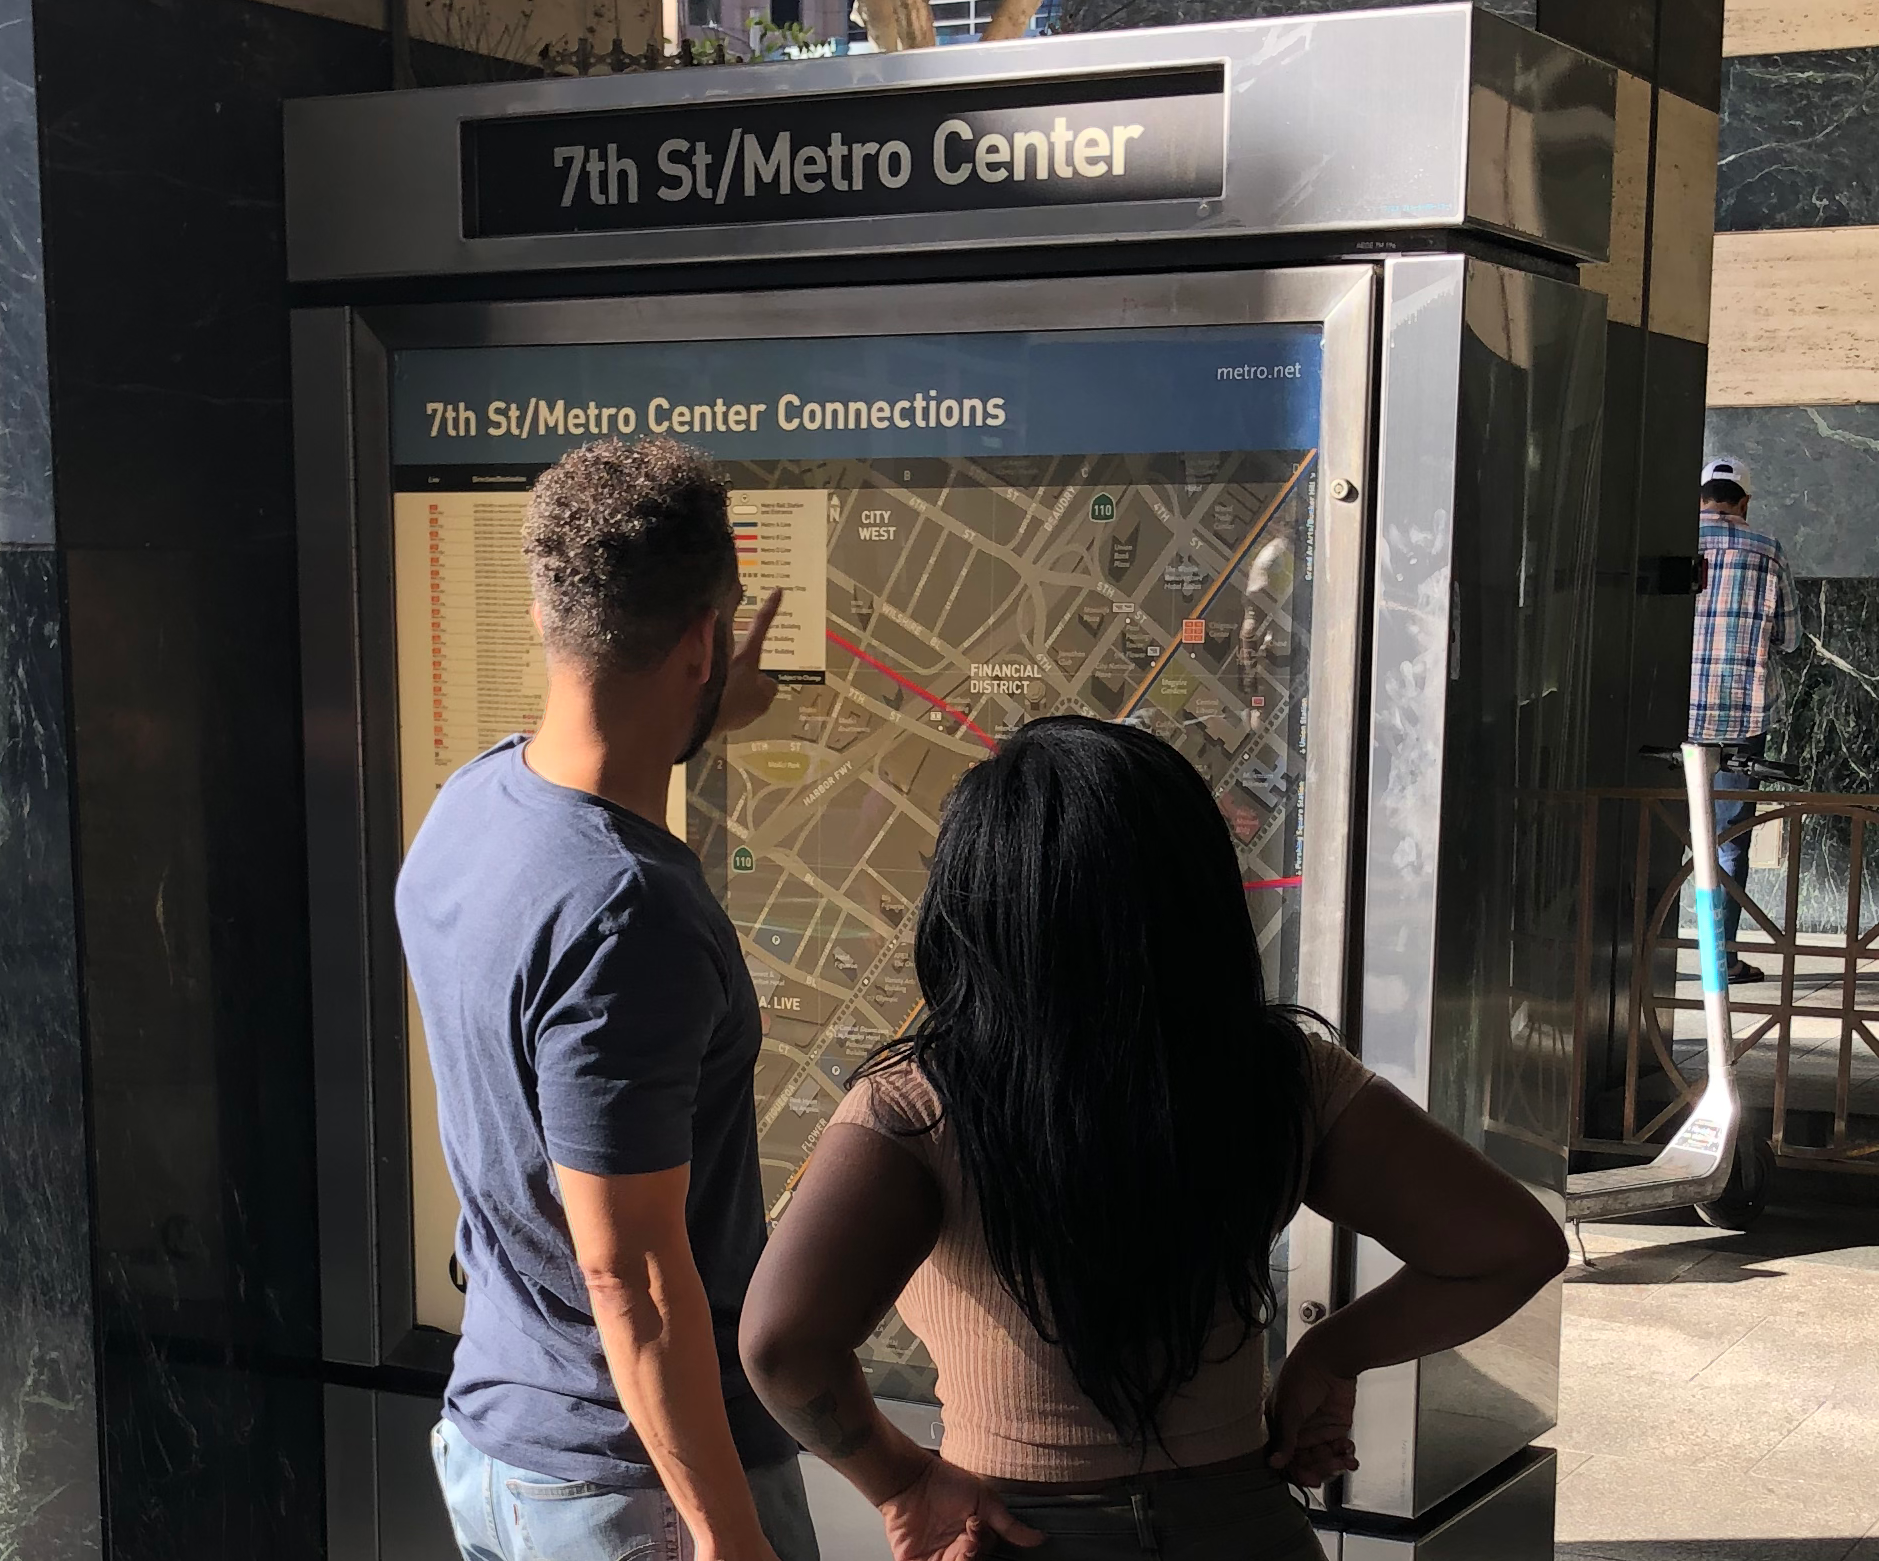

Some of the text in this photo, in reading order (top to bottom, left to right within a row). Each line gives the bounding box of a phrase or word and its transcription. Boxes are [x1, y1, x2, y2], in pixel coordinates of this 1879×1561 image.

[553, 117, 1145, 207] 7th St/Metro Center
[1216, 362, 1302, 380] metro.net
[425, 389, 1007, 439] 7th St/Metro Center Connections
[829, 506, 840, 522] N
[861, 510, 892, 524] CITY
[1094, 504, 1112, 516] 110
[858, 526, 897, 541] WEST
[970, 663, 1042, 678] FINANCIAL
[970, 680, 1030, 694] DISTRICT
[717, 760, 723, 770] 2
[735, 857, 752, 867] 110
[773, 996, 801, 1011] LIVE
[801, 1116, 828, 1153] FLOWER
